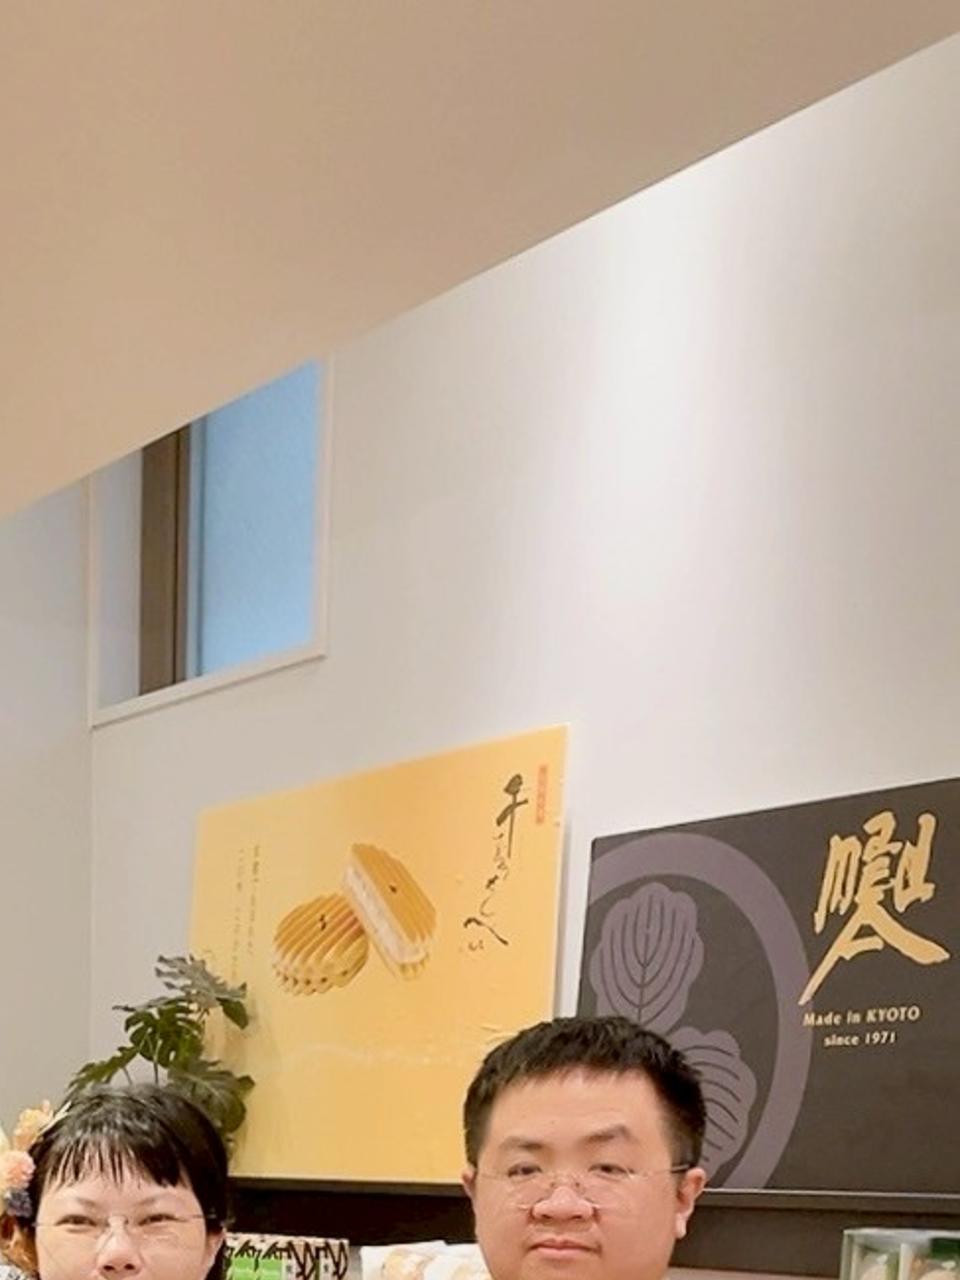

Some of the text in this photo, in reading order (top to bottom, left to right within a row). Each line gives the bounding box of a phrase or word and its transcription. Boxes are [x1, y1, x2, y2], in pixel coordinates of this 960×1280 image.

[803, 1005, 920, 1027] Made in KYOTO
[824, 1030, 896, 1047] since 1971
